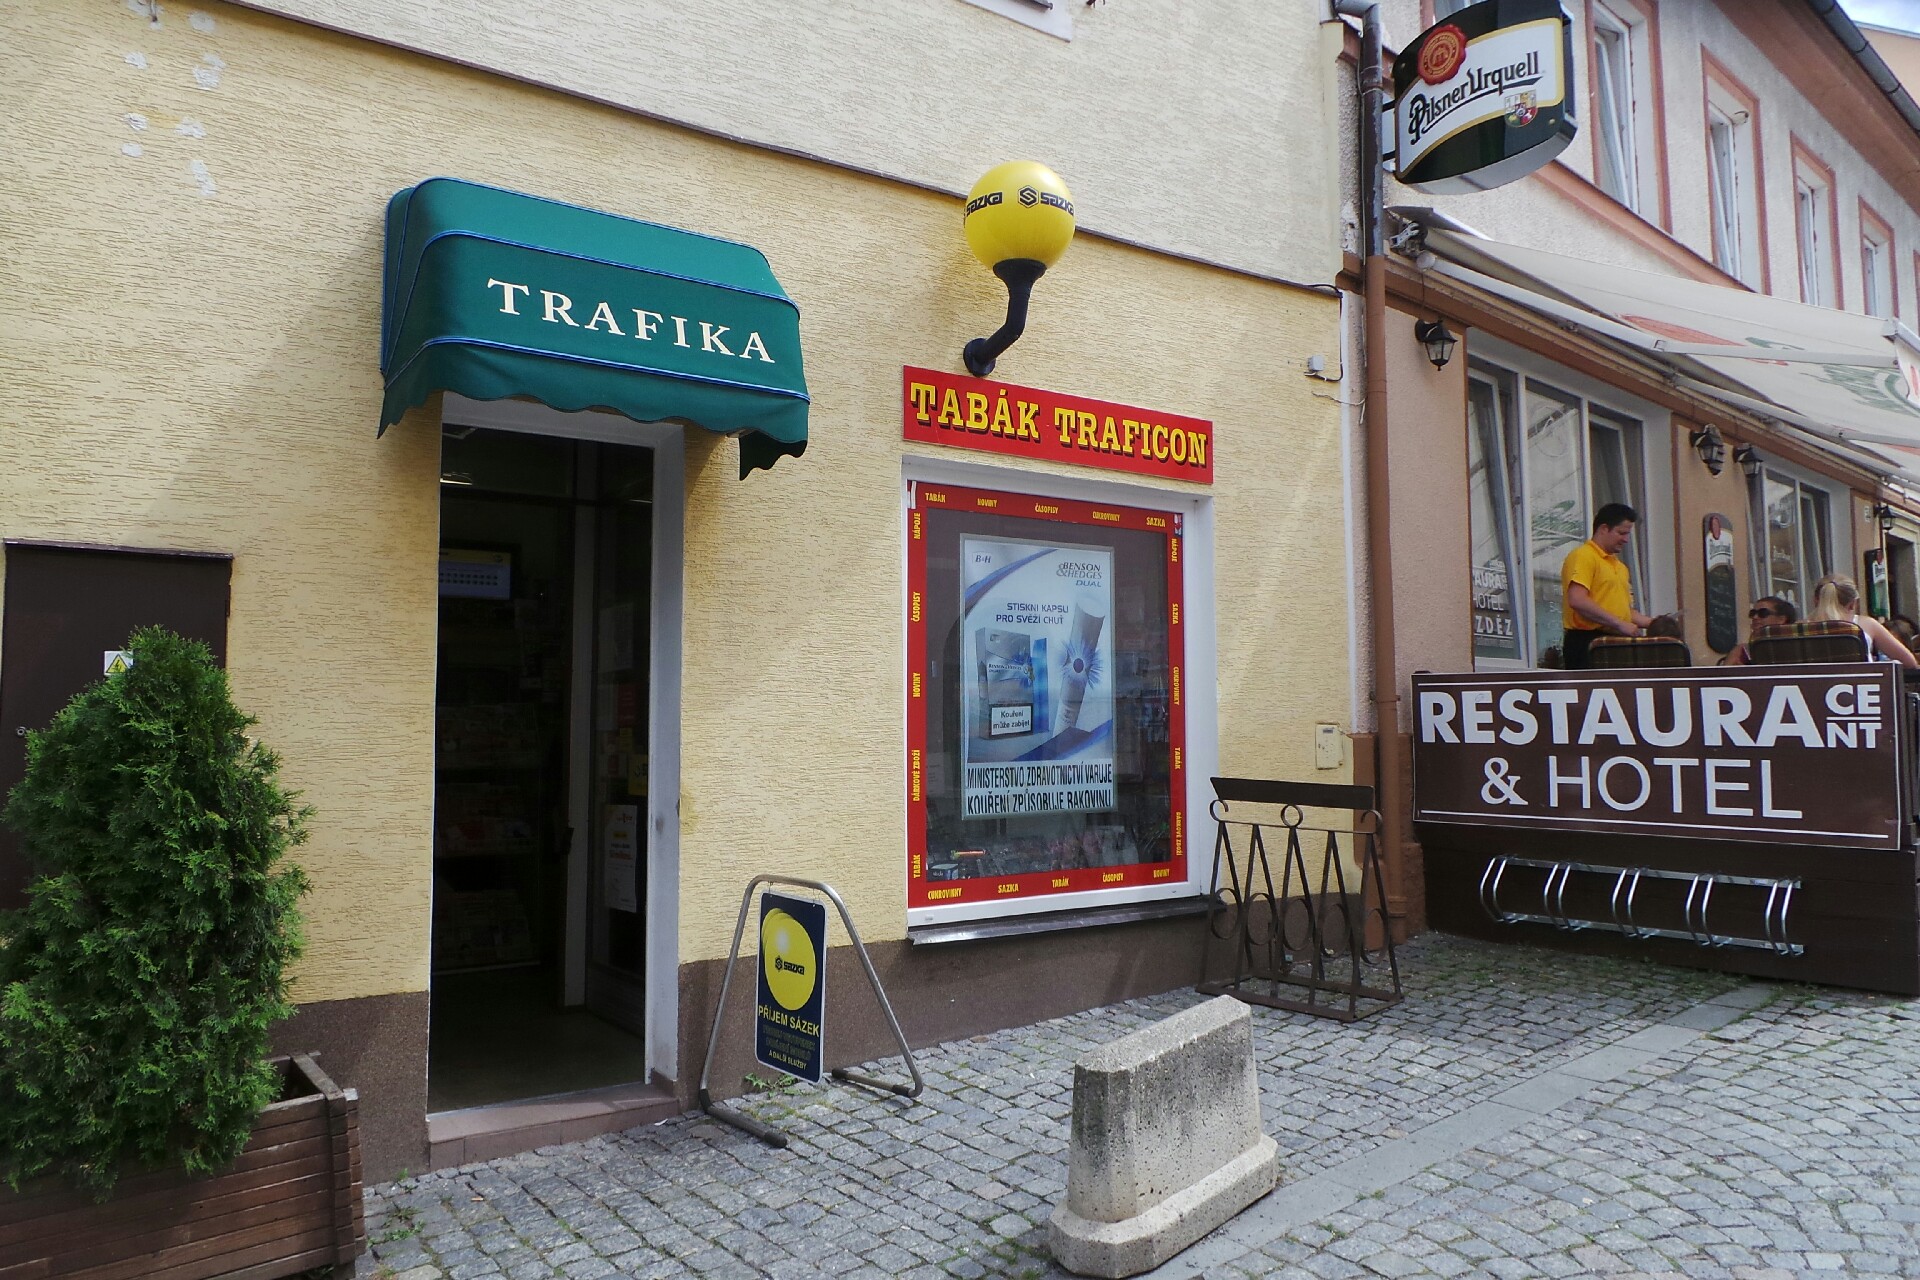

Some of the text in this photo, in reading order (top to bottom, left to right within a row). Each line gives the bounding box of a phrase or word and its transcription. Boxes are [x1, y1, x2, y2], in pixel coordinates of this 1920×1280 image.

[1408, 81, 1471, 145] Pilsner
[1467, 51, 1539, 96] Urquell
[487, 278, 776, 364] TRAFIKA
[910, 381, 1208, 469] TABÁK TRAFICON
[977, 498, 998, 508] NOVINY
[1035, 503, 1059, 514] ČASOPISY
[1092, 511, 1121, 522] CUKROVINKY
[1146, 516, 1166, 527] SAZKA
[1063, 562, 1101, 572] BENSON
[1075, 579, 1102, 588] DUAL
[911, 591, 921, 622] ČASOPISY
[1007, 602, 1069, 613] STISKNI KAPSU
[996, 614, 1014, 623] PRO
[1016, 614, 1041, 624] SVĚŽÍ
[912, 672, 921, 698] NOVINY
[1420, 683, 1882, 748] RESTAURA CE
[1827, 722, 1882, 748] NT
[911, 750, 921, 802] DÁRKOVÉ ZBOŽÍ
[967, 761, 1112, 789] MINISTERSTVO ZDRAVOTNICTVÍ VARUJE
[1480, 755, 1803, 819] & HOTEL
[967, 789, 1111, 815] KOUŘENÍ ZPŮSOBUJE RAKOVINU
[913, 854, 921, 878] TABÁK
[1102, 872, 1124, 883] ČASOPISY
[1153, 868, 1170, 878] NOVINY
[998, 883, 1019, 894] SAZKA
[1052, 876, 1070, 888] TABÁK
[927, 887, 962, 900] CUKROVINKY
[758, 1004, 788, 1027] PŘÍJEM
[789, 1016, 820, 1038] SÁZEK
[768, 1049, 773, 1057] A
